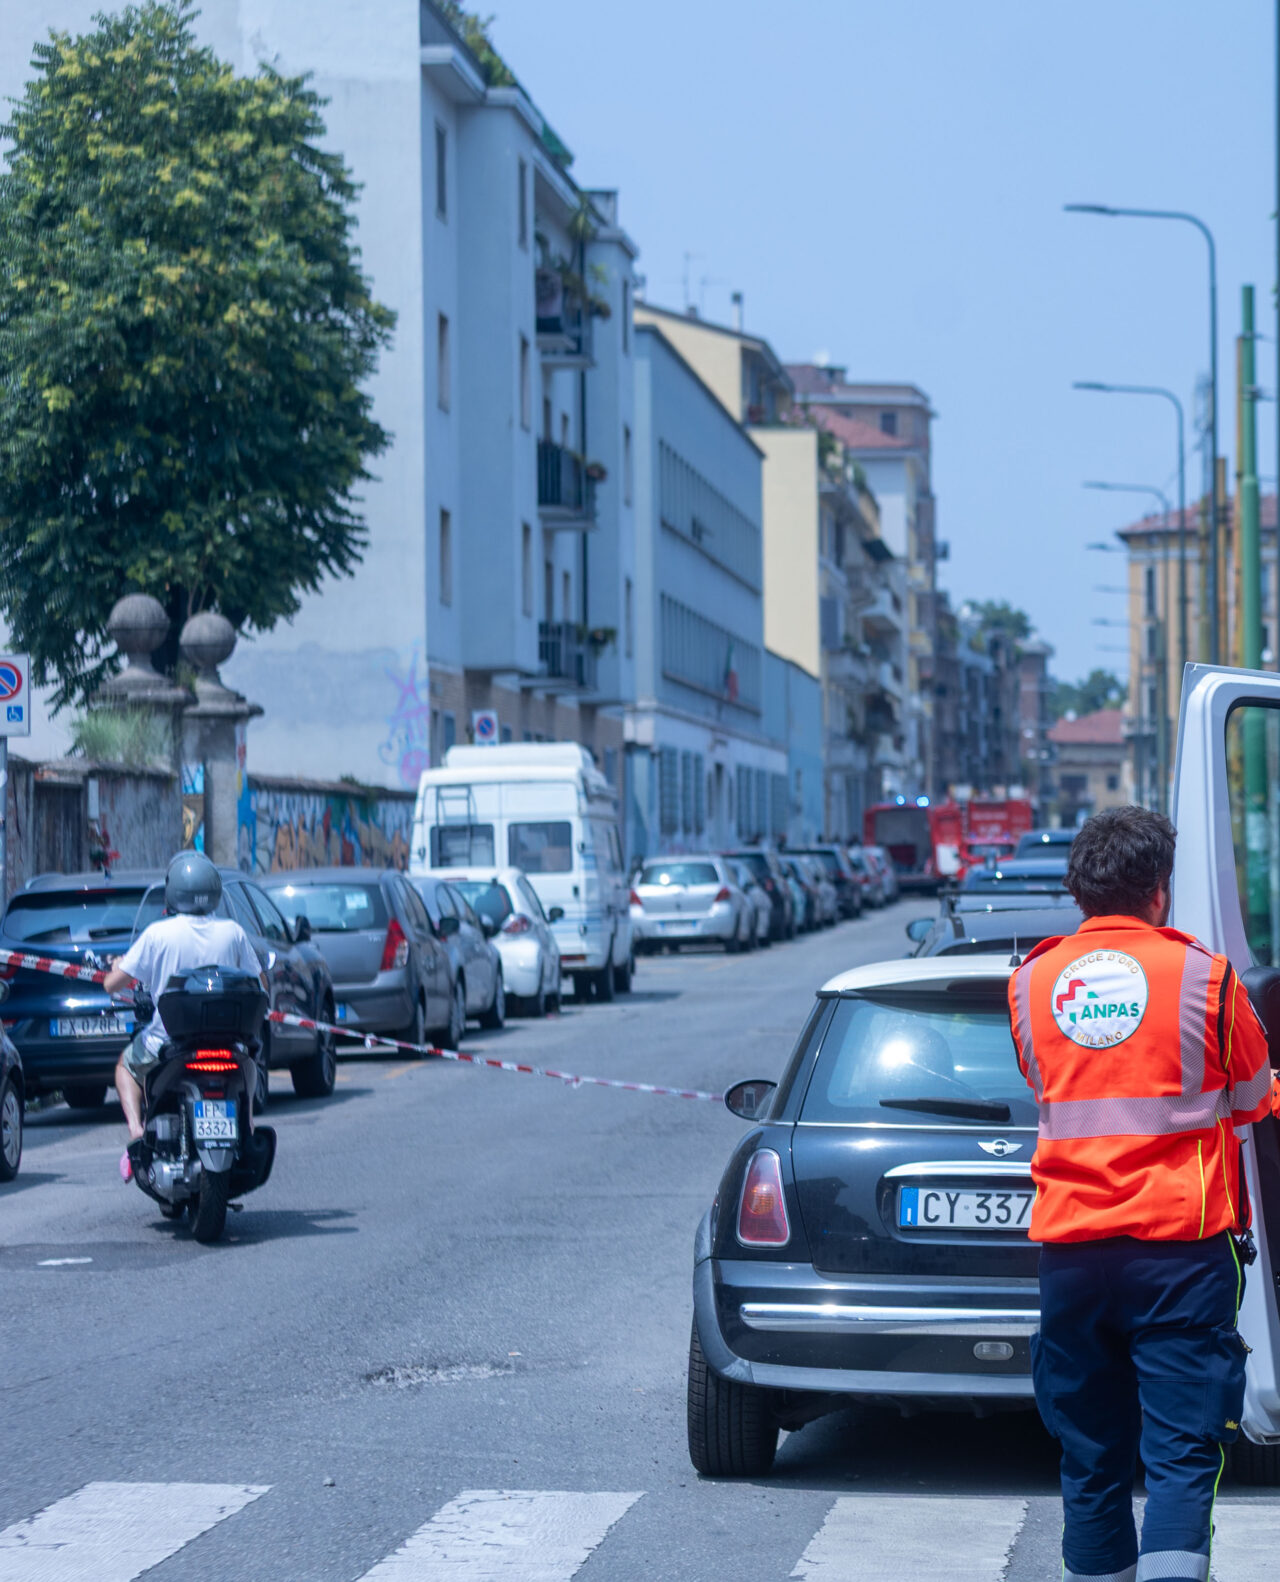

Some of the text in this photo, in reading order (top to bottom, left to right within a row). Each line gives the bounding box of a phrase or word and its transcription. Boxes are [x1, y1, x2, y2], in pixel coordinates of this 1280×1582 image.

[1063, 952, 1139, 979] CROCE D'ORO
[1081, 1002, 1139, 1020] ANPAS
[1075, 1031, 1123, 1046] MILANO
[198, 1121, 233, 1136] 33321
[923, 1192, 960, 1223] CY
[975, 1193, 1033, 1224] 337
